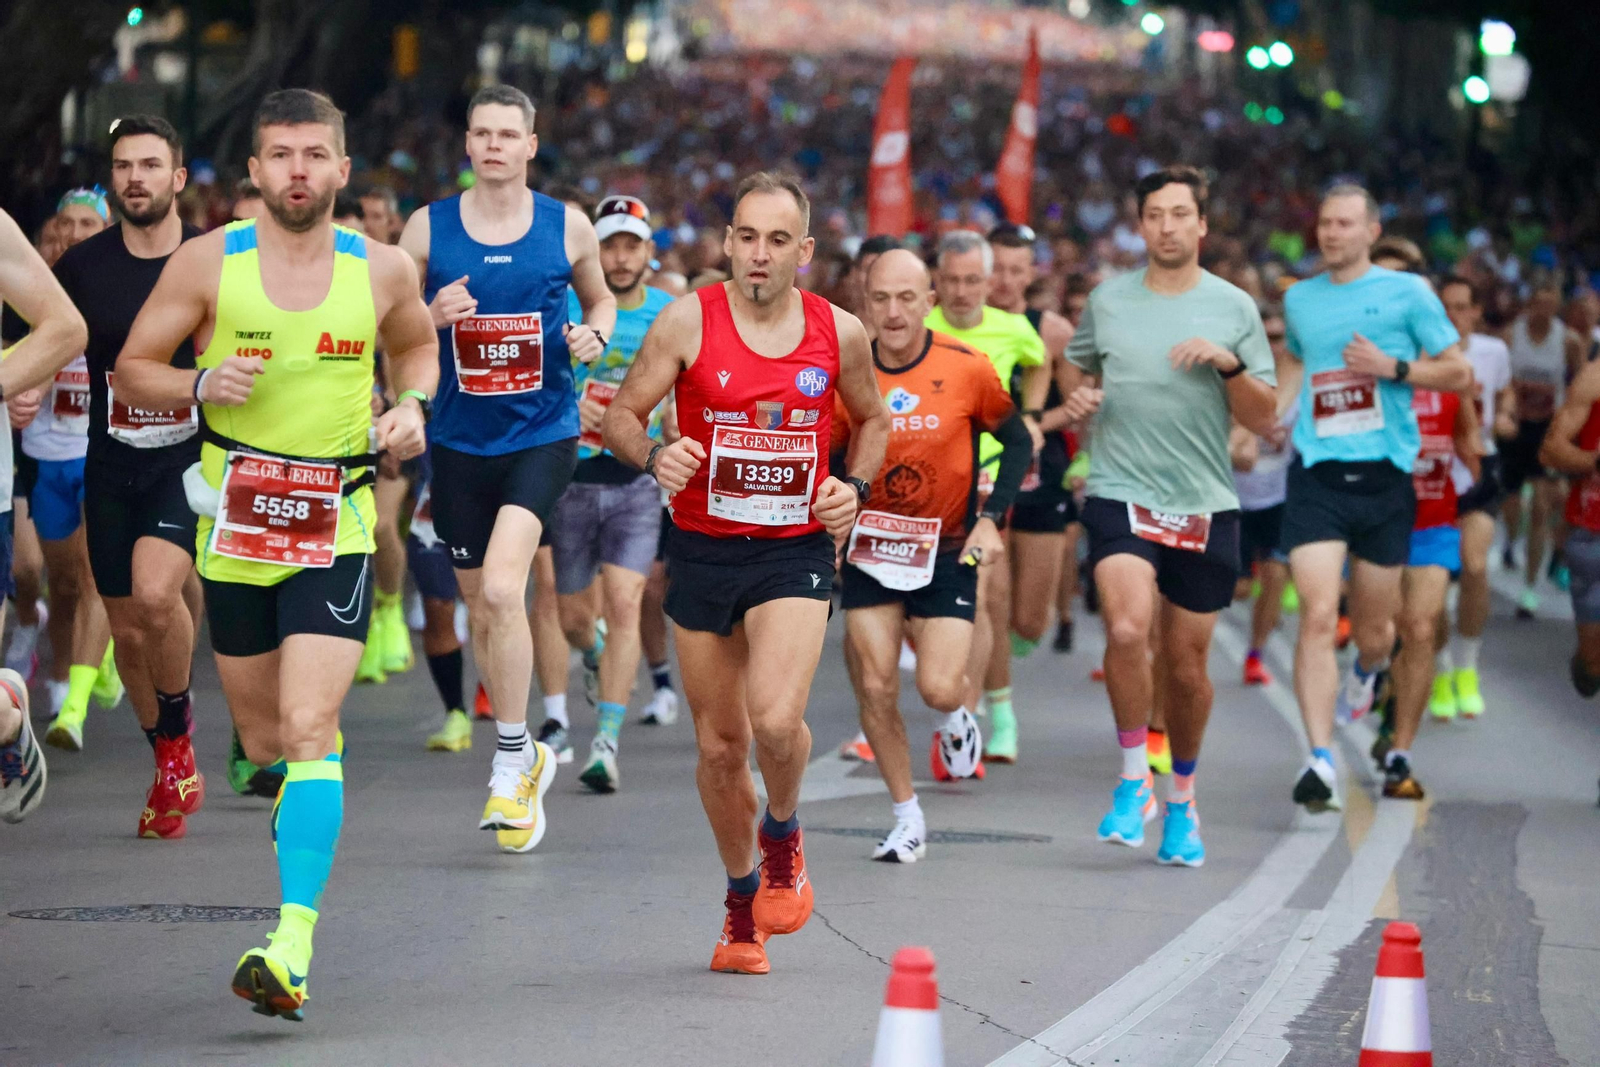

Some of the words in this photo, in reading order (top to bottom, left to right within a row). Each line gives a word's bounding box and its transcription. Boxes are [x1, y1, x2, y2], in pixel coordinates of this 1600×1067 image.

[484, 256, 513, 264] FUSION
[476, 318, 535, 331] GENERALI
[235, 331, 272, 340] TRIMTEX
[315, 332, 365, 355] Anu
[477, 344, 520, 359] 1588
[715, 411, 748, 420] EGEA
[743, 434, 809, 451] GENERALI
[260, 464, 335, 486] GENERALI
[734, 463, 795, 484] 13339
[744, 483, 782, 492] SALVATORE
[252, 494, 310, 520] 5558
[268, 517, 290, 527] EERO
[877, 517, 934, 534] GENERALI
[870, 538, 919, 559] 14007
